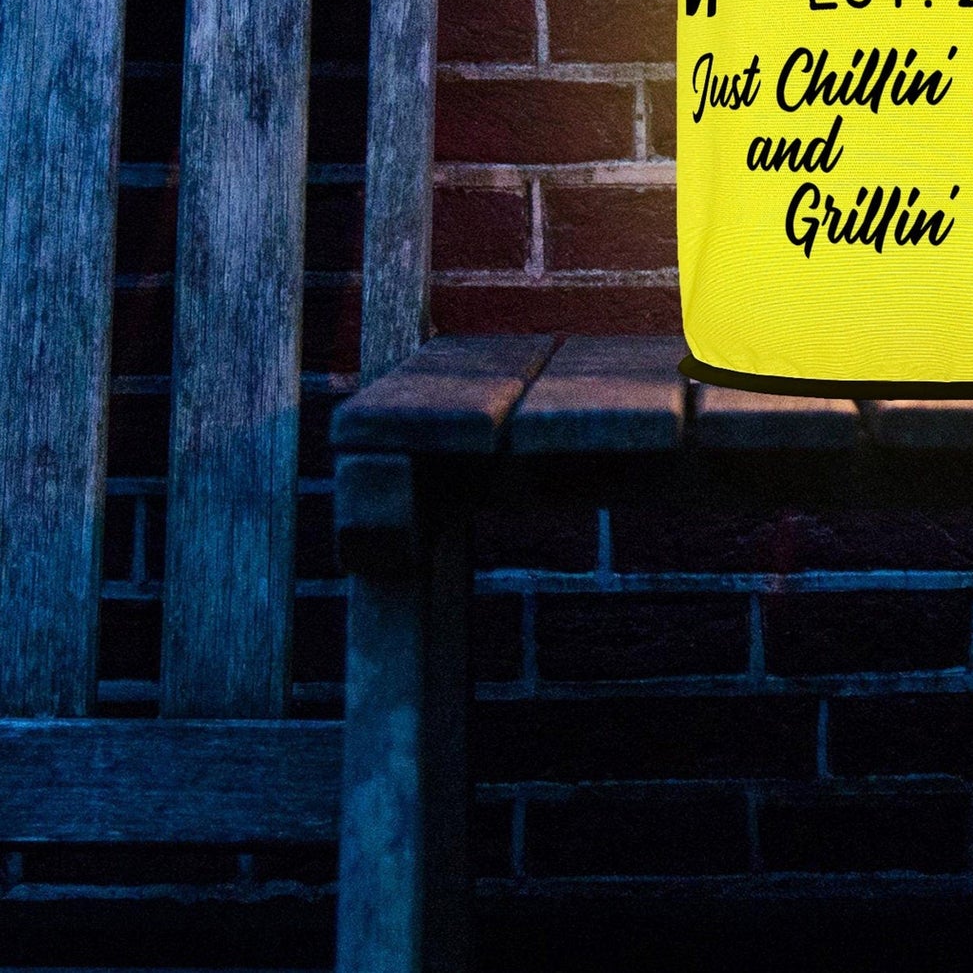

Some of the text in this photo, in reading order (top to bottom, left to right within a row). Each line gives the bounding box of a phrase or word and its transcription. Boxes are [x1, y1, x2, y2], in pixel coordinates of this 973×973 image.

[692, 45, 959, 124] Just Chillin'
[746, 114, 845, 174] and
[785, 182, 961, 259] Grillin'
